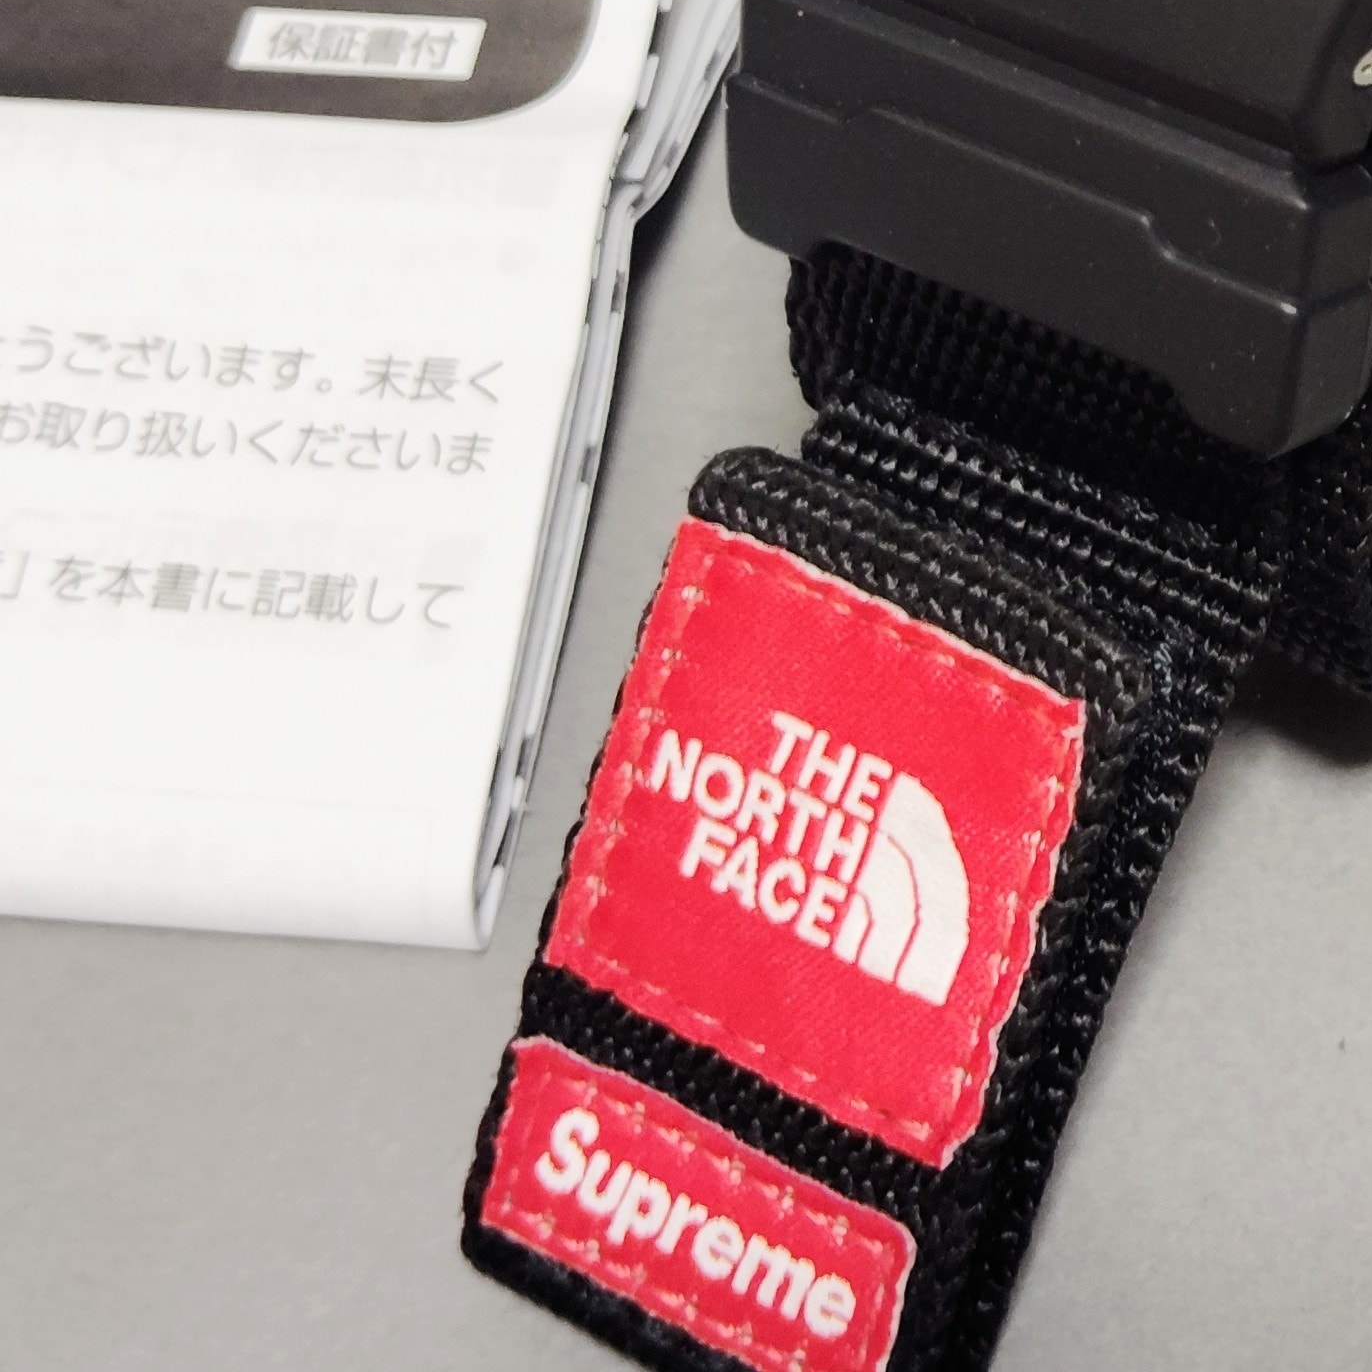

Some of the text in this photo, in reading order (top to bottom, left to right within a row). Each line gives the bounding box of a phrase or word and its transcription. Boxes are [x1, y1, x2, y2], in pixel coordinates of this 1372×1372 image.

[266, 19, 460, 71] 保証書付
[0, 325, 505, 404] うございます。末長く
[0, 547, 466, 630] 」を本書に記載して
[649, 728, 874, 885] NORTH
[770, 710, 894, 824] THE
[678, 821, 856, 948] FACE
[533, 1105, 857, 1341] Supreme
